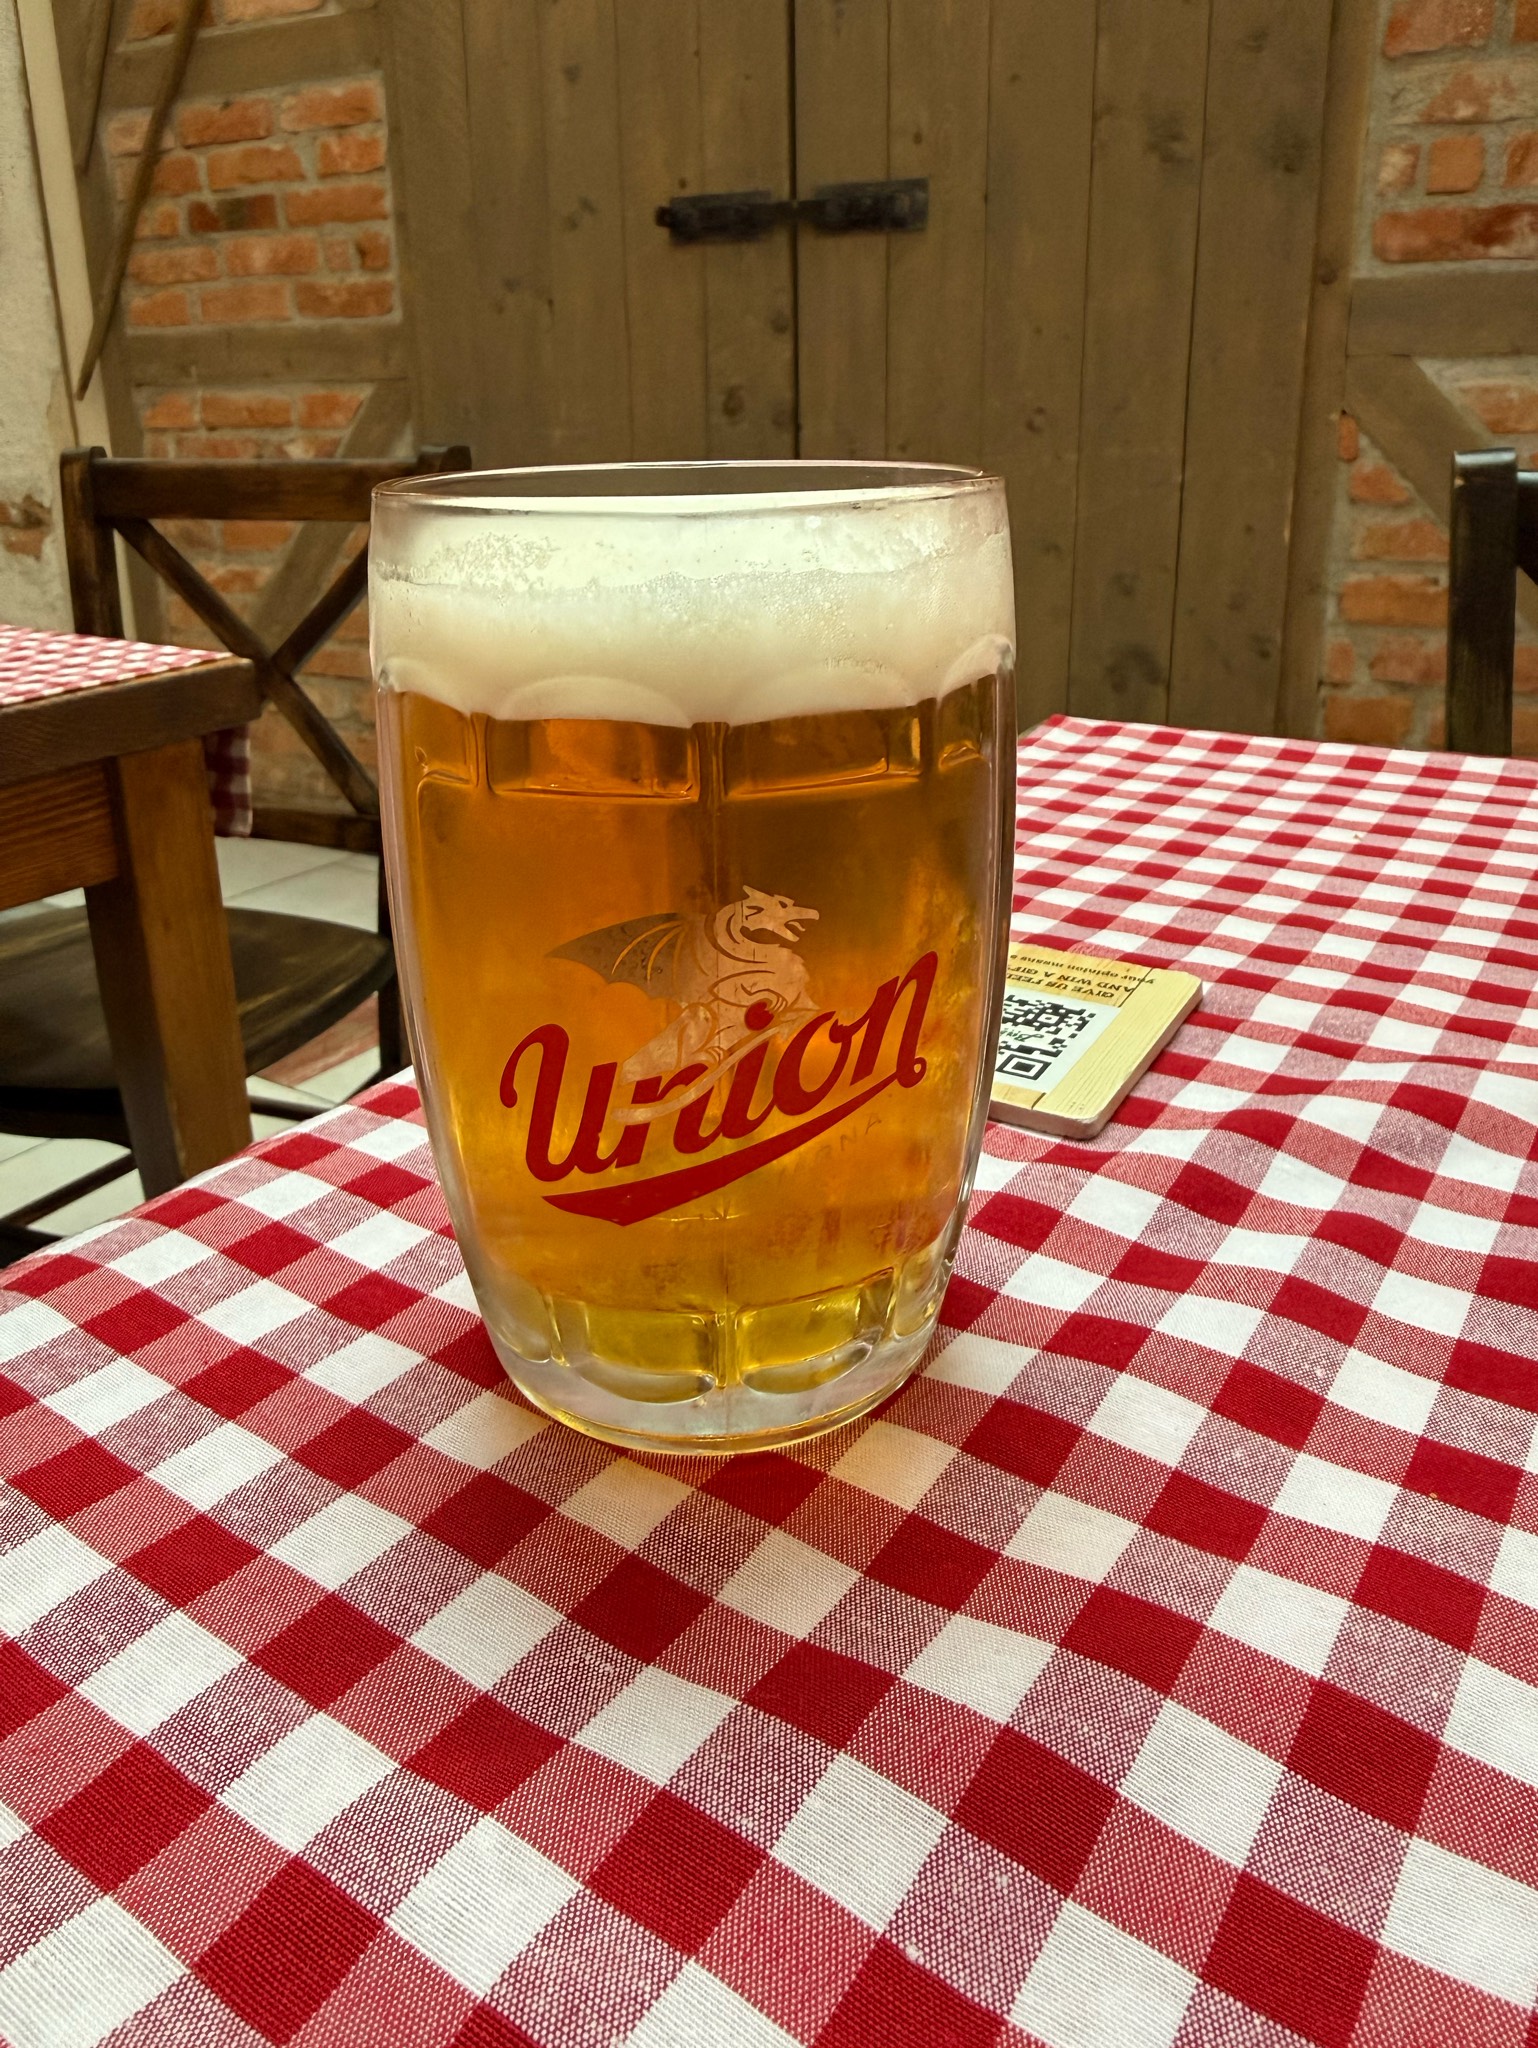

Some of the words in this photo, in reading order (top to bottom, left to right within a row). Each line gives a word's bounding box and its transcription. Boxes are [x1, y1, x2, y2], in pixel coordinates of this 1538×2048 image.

[1020, 955, 1065, 968] means
[1067, 963, 1119, 978] opinion
[1044, 980, 1069, 991] US
[1057, 973, 1092, 987] WIN
[1120, 974, 1157, 985] your
[1070, 986, 1115, 999] GIVE
[1096, 981, 1136, 993] AND
[500, 951, 939, 1183] Union
